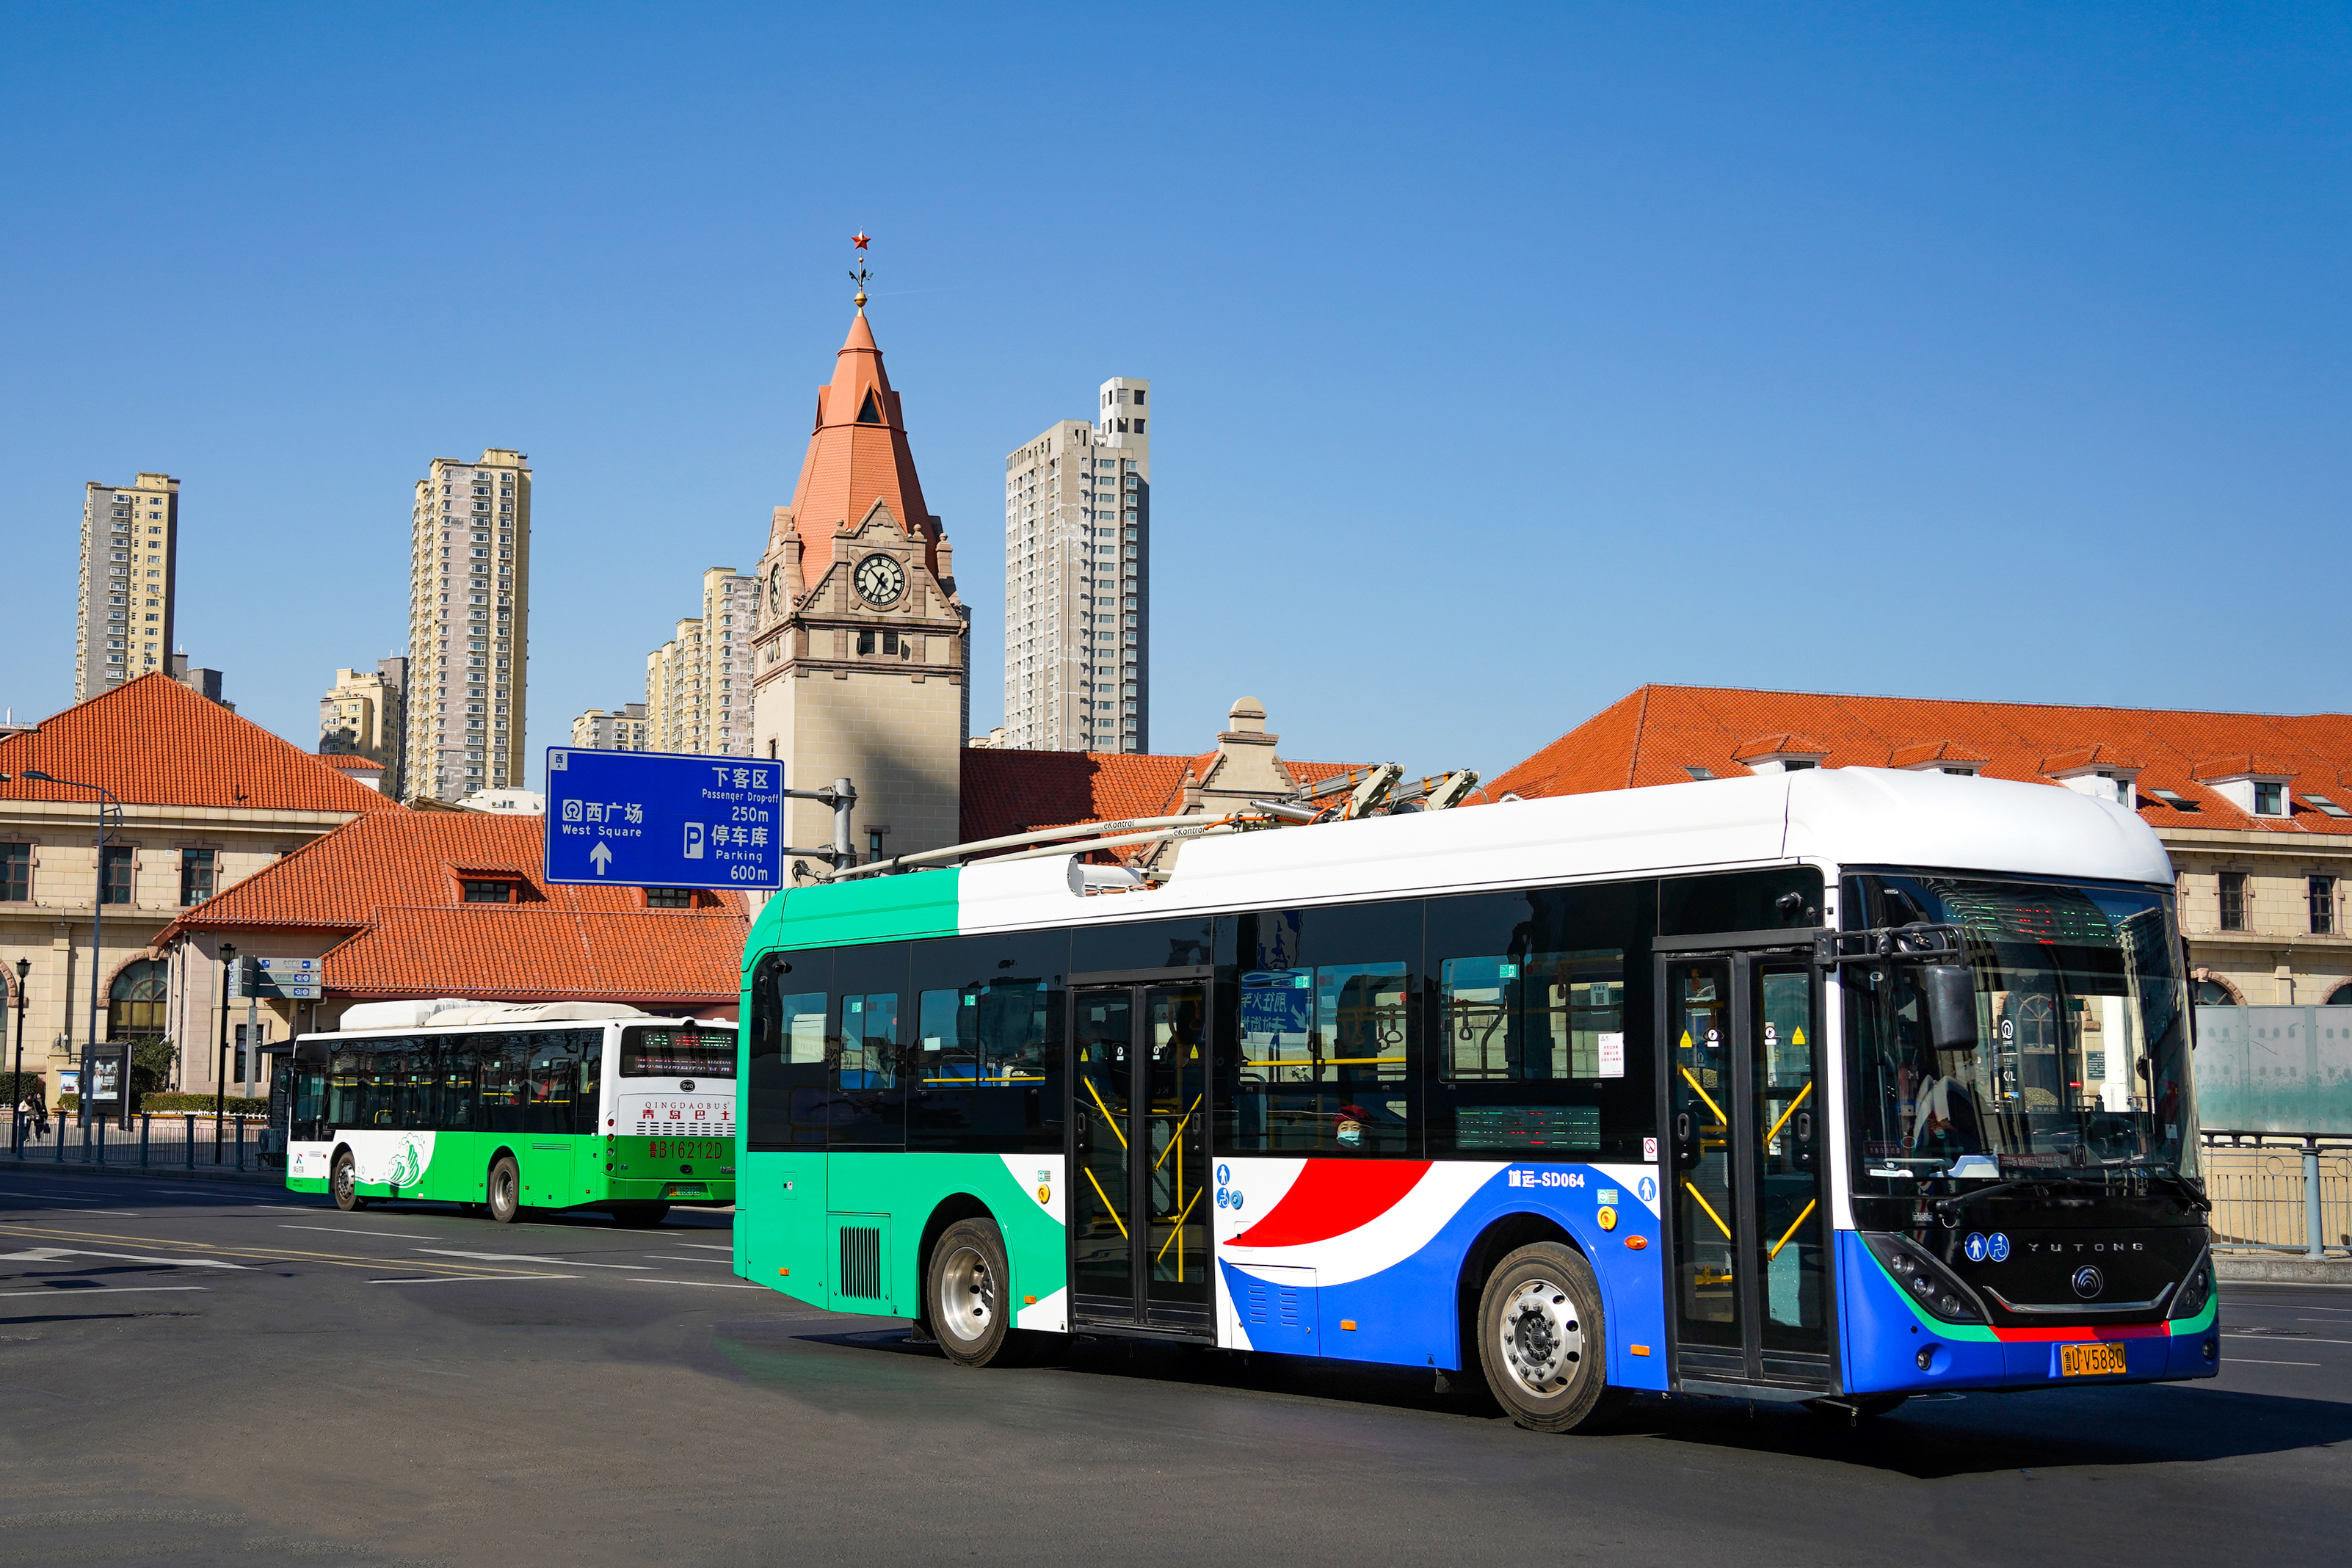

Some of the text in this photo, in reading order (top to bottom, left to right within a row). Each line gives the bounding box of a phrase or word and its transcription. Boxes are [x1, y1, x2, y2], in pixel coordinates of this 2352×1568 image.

[556, 754, 563, 763] 西
[712, 767, 769, 789] 下客区
[702, 788, 779, 805] Passenger Drop-off
[585, 802, 643, 824] 西广场
[731, 805, 769, 822] 250m
[562, 824, 642, 838] West Square
[1103, 819, 1136, 830] eKontrol
[686, 826, 702, 854] P
[711, 824, 769, 848] 停车库
[716, 849, 763, 864] Parking
[730, 865, 768, 881] 600m
[645, 1102, 727, 1110] QINGDAOBUS
[642, 1109, 730, 1120] 青岛巴士
[649, 1141, 722, 1159] 鲁B16212D
[2028, 1243, 2143, 1252] YUTONG
